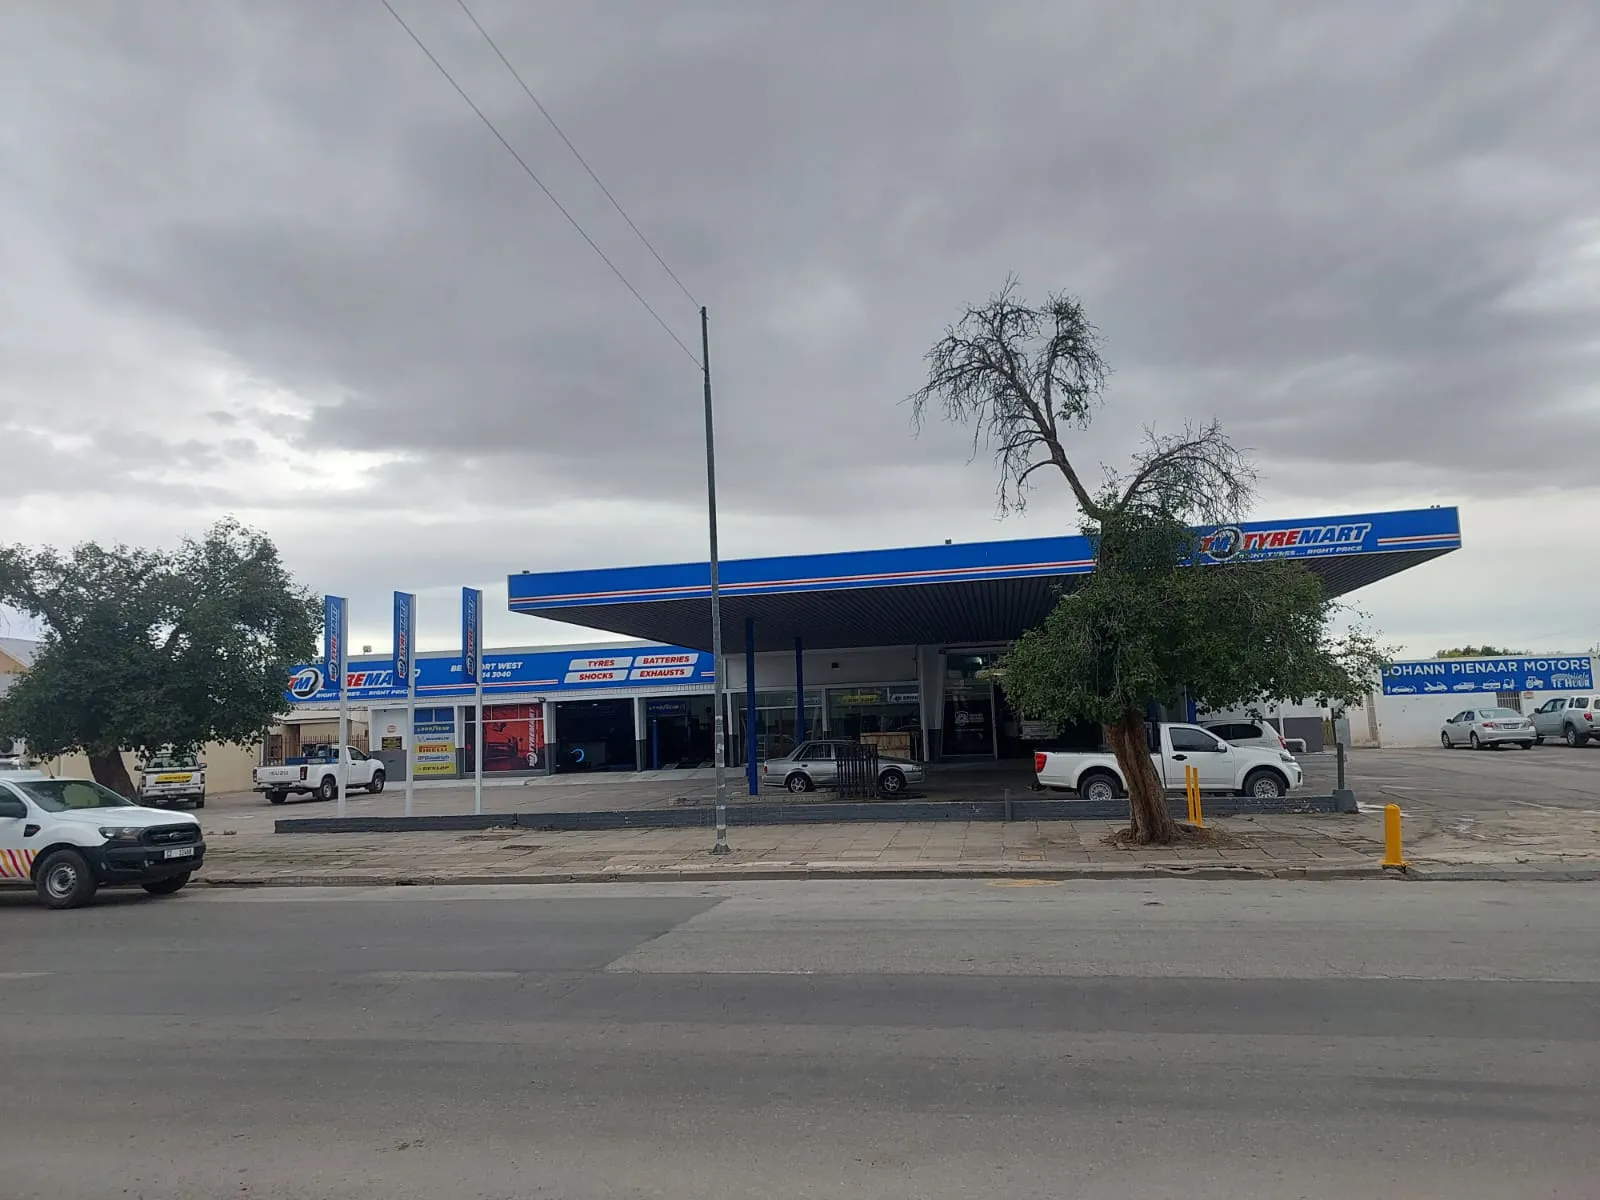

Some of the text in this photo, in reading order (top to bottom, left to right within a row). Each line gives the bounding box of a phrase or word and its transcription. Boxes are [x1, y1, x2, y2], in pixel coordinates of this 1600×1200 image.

[1243, 525, 1367, 549] TYREMART
[1307, 547, 1335, 555] RIGHT
[643, 656, 689, 664] BATTERIES
[498, 661, 523, 670] WEST
[1383, 659, 1590, 676] JOHANN PIENAAR MOTORS
[578, 672, 613, 680] SHOCKS
[640, 669, 685, 677] EXHAUSTS
[418, 744, 448, 752] PIRELLI
